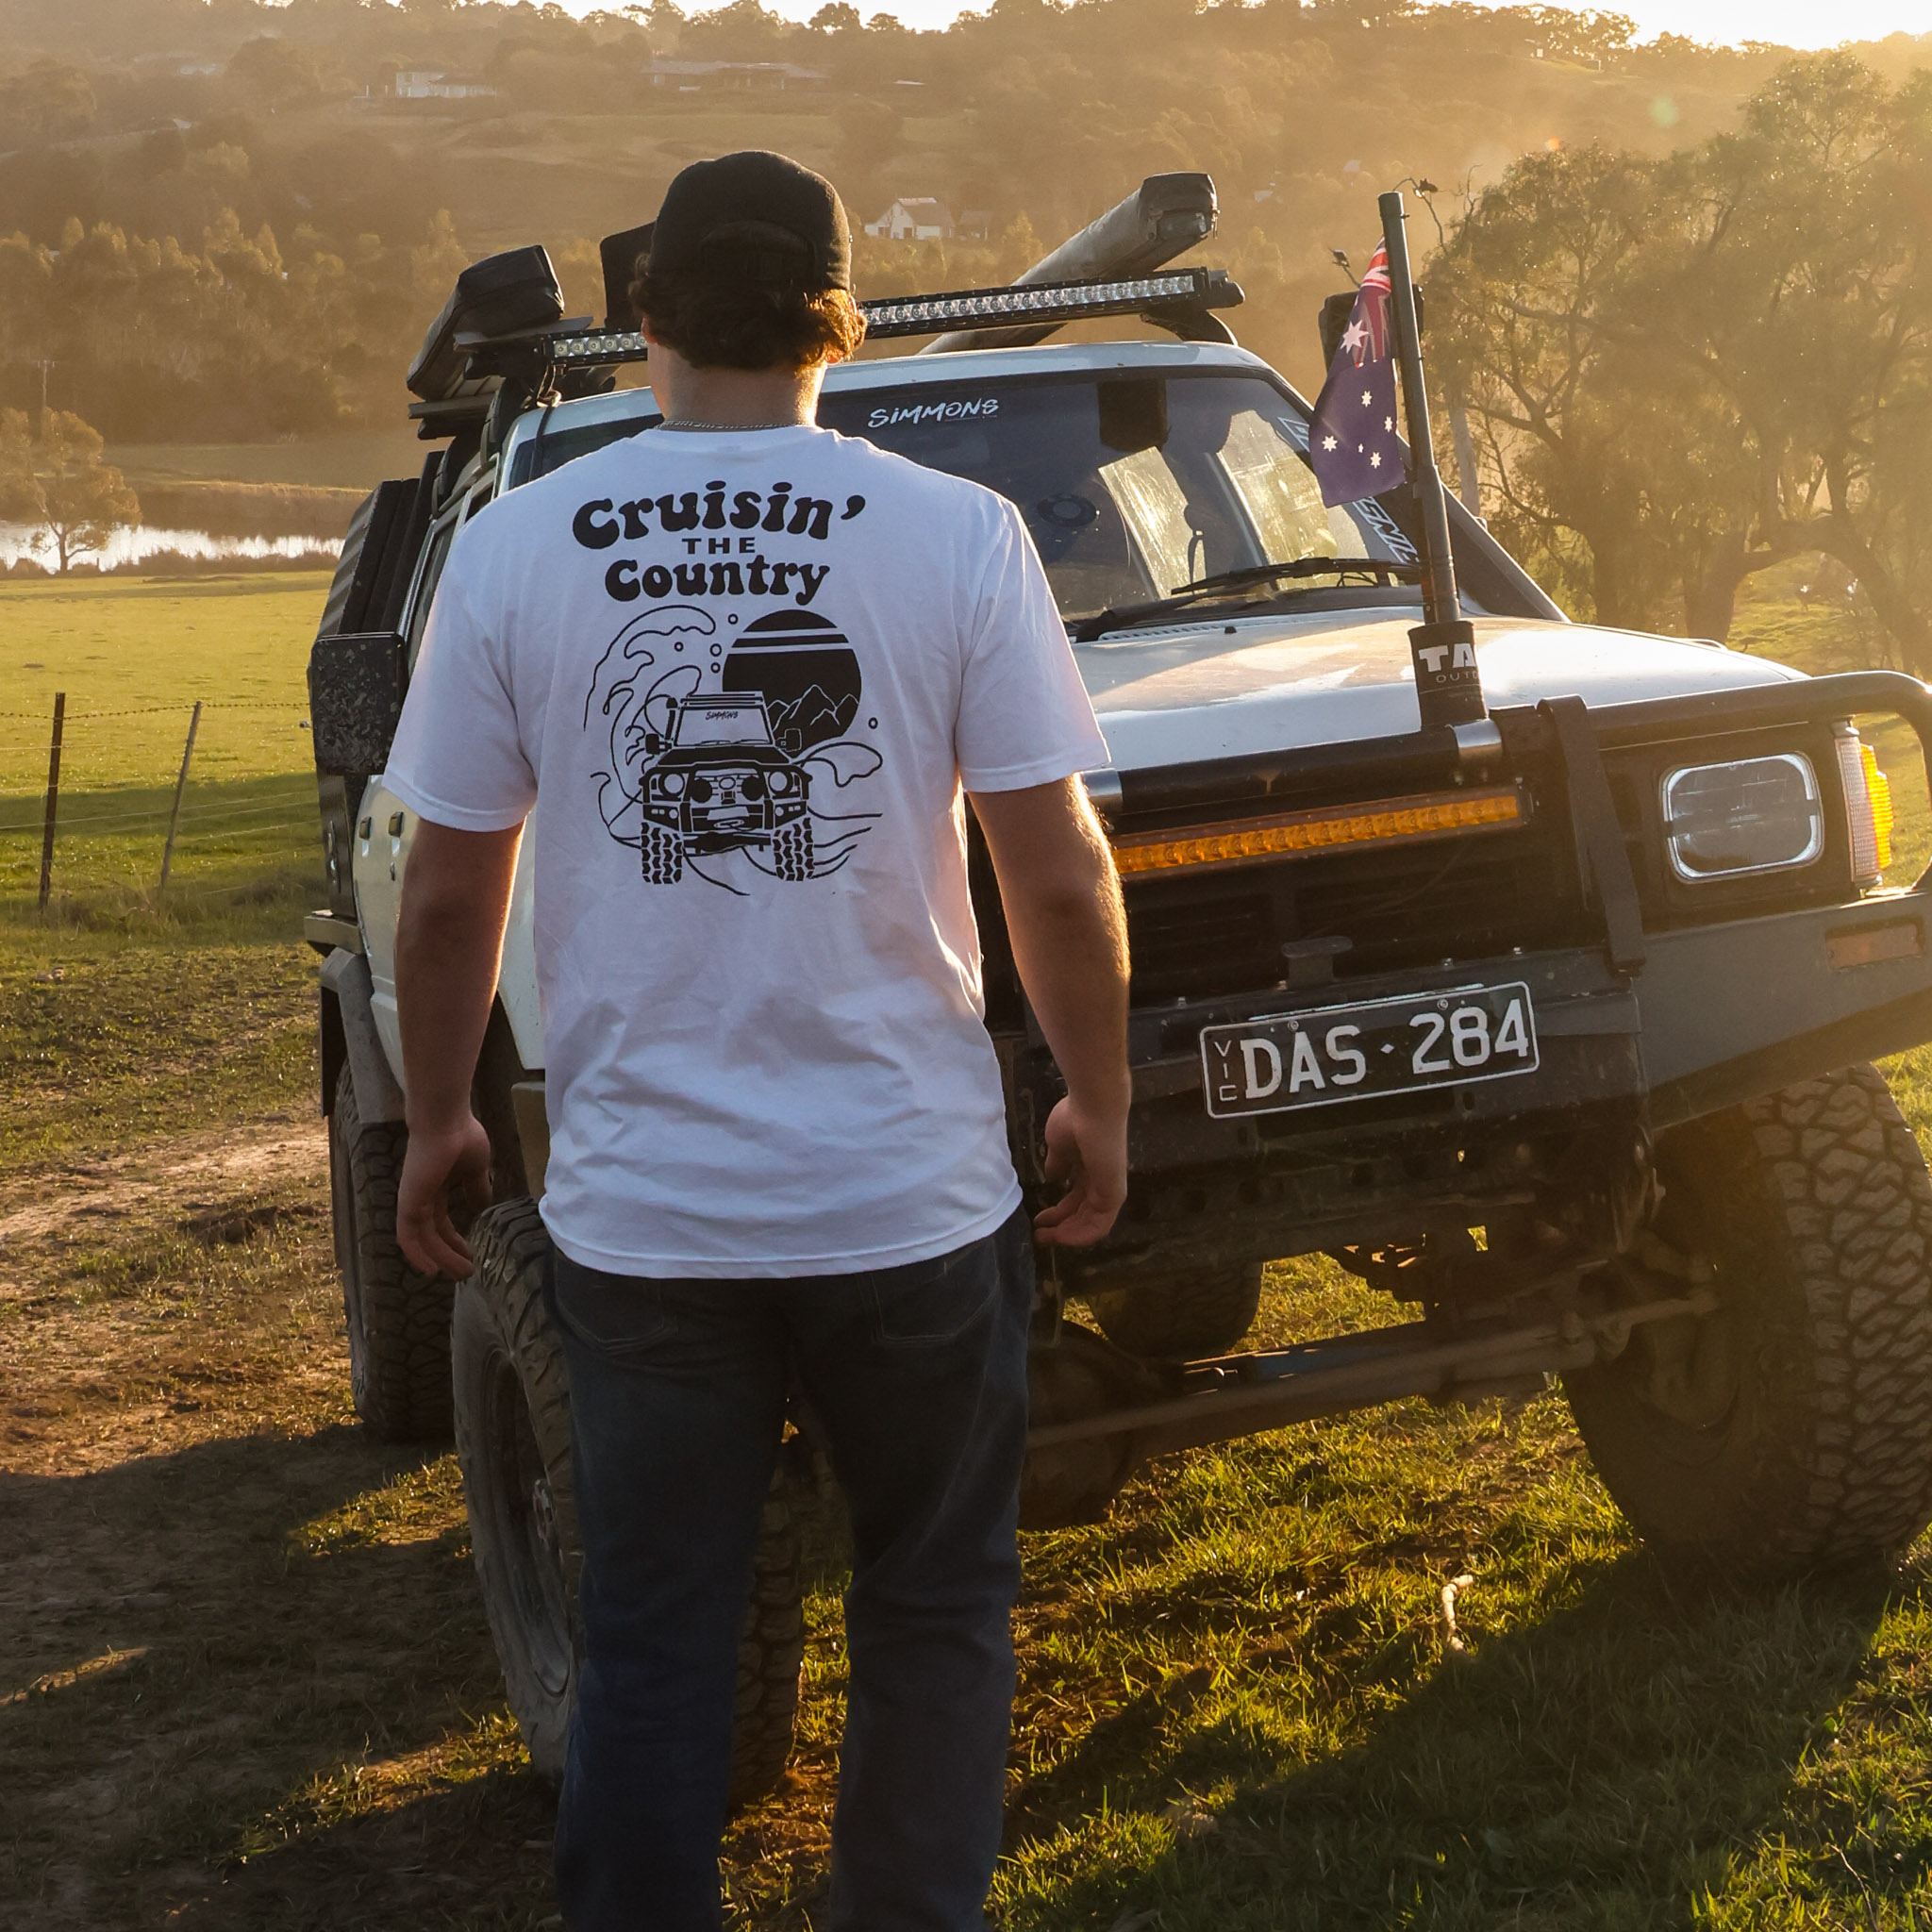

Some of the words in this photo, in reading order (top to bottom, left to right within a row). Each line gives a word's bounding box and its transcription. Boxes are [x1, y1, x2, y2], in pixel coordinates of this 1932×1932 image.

[572, 480, 866, 549] Cruisin'
[681, 537, 756, 555] THE
[604, 555, 831, 607] Country
